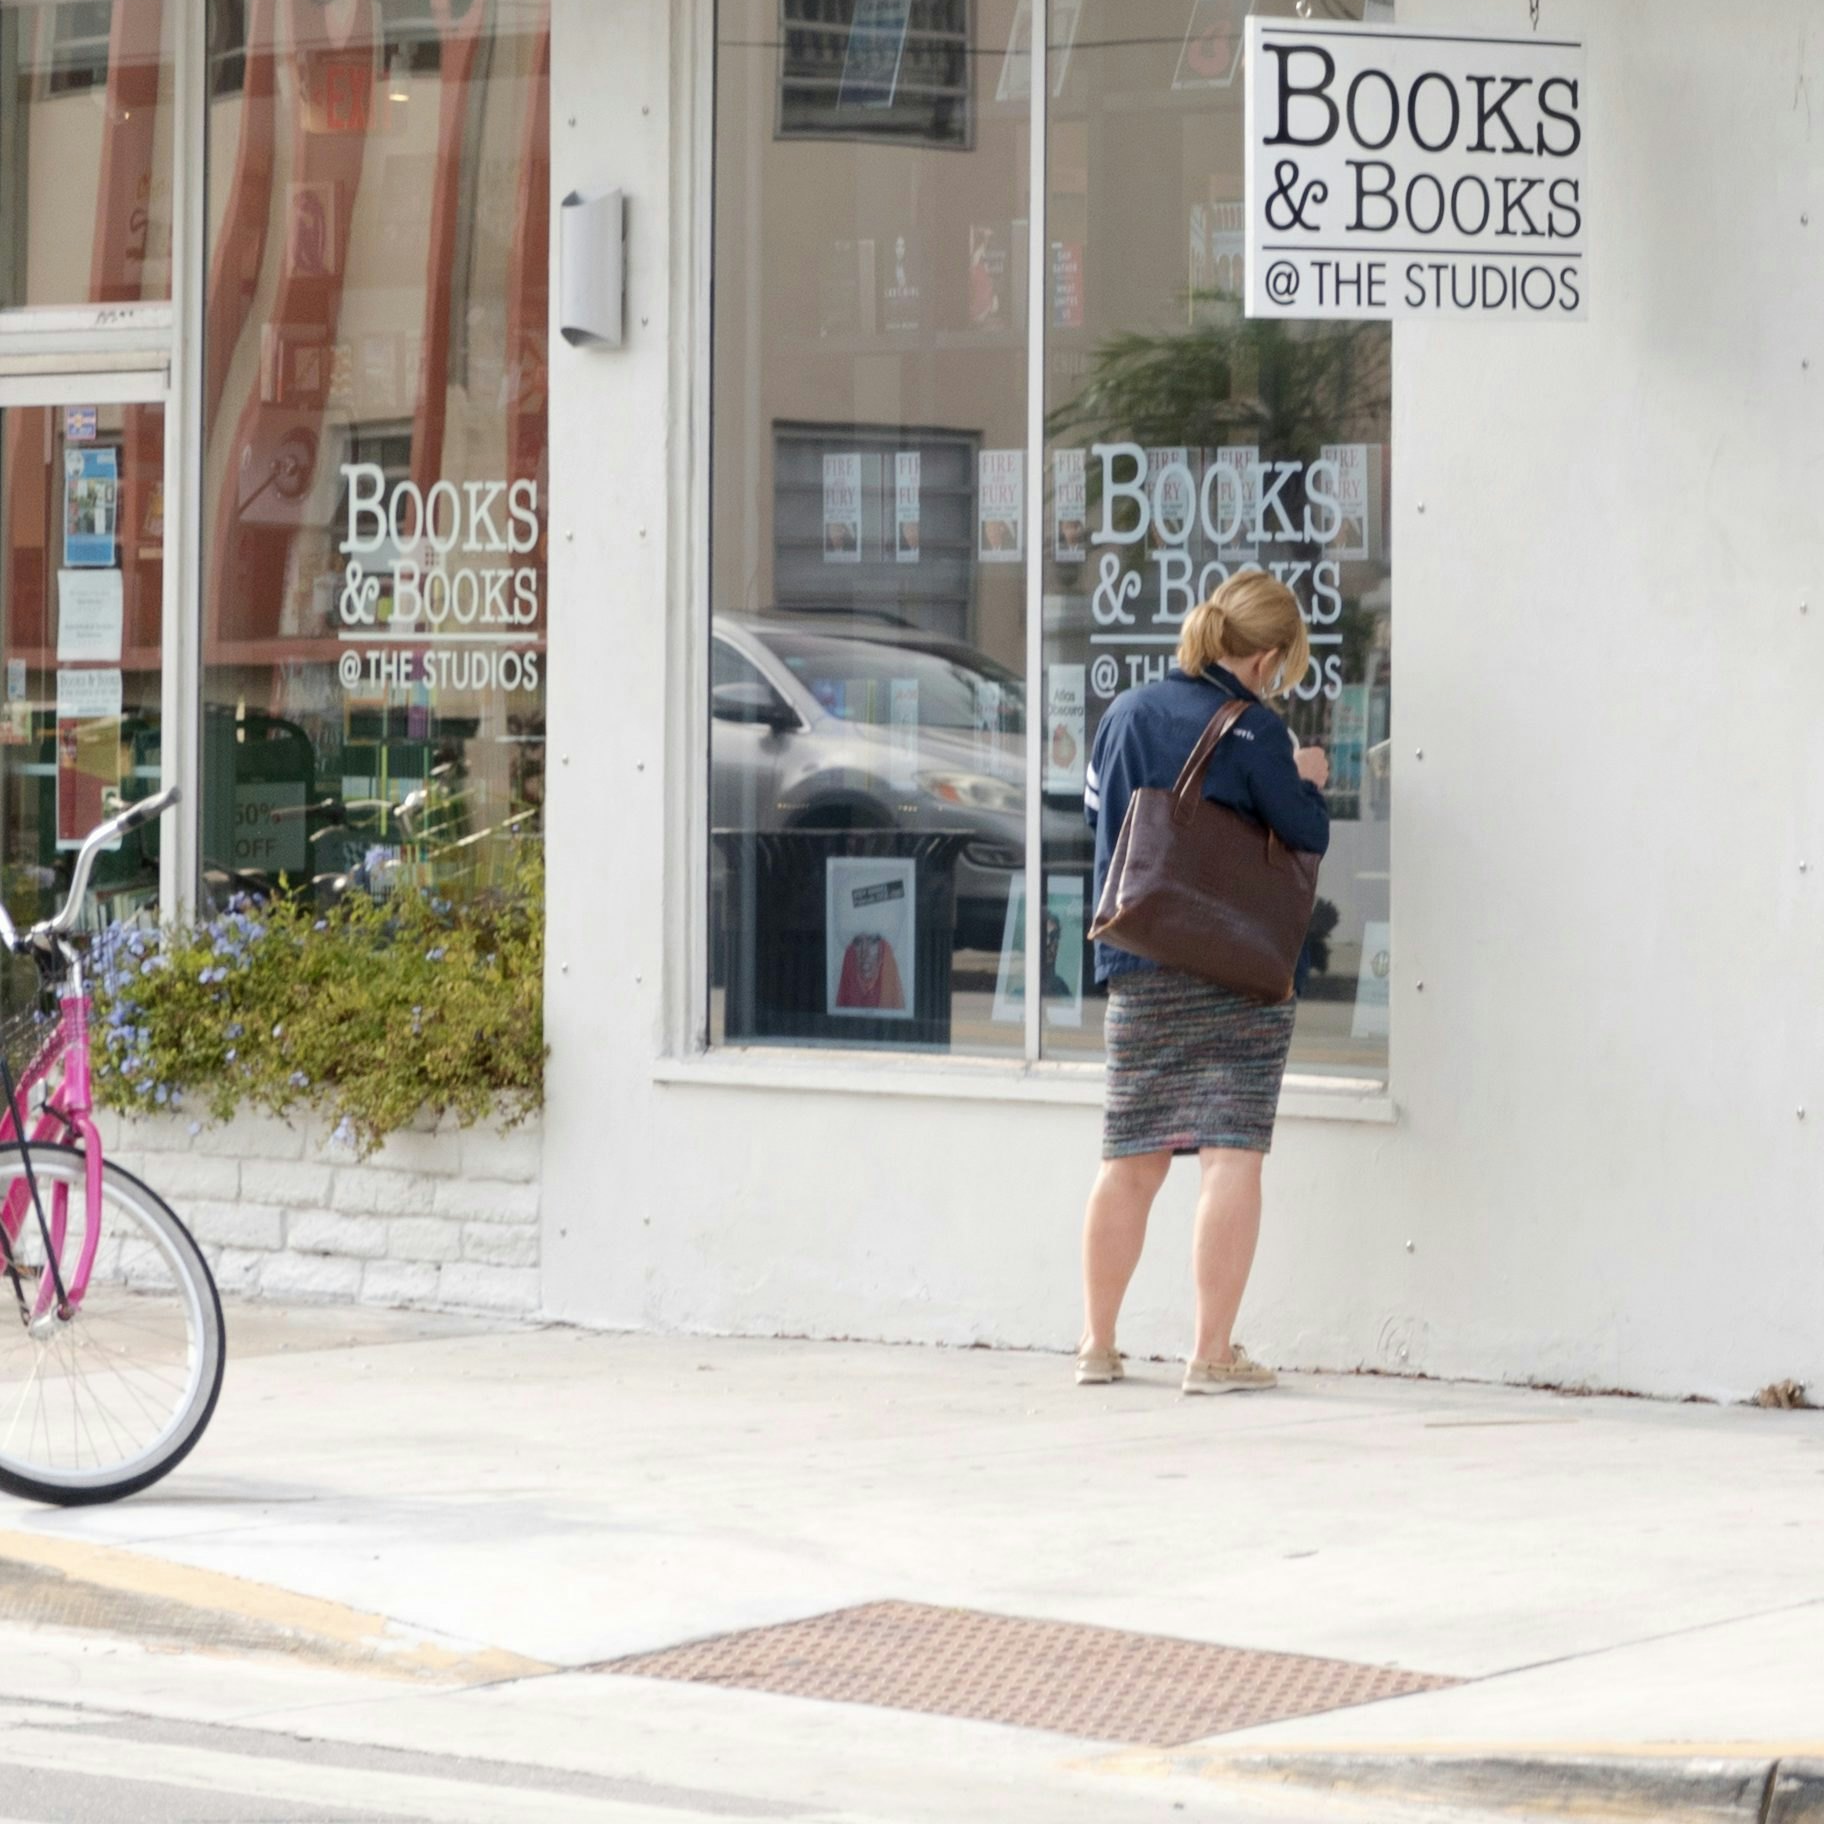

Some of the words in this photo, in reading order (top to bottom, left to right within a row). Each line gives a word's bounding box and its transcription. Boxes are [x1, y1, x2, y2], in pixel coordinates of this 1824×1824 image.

[1262, 42, 1582, 157] BOOKS
[1264, 159, 1328, 232] &
[1345, 159, 1582, 239] BOOKS
[1265, 260, 1300, 305] @
[1310, 261, 1387, 307] THE
[1404, 262, 1581, 311] STUDIOS
[338, 463, 539, 555] BOOKS
[1090, 442, 1343, 545] BOOKS
[338, 559, 380, 625] &
[387, 559, 538, 626] BOOKS
[1091, 552, 1142, 625] &
[338, 650, 361, 691] @
[365, 650, 414, 691] THE
[421, 650, 539, 692] STUDIOS
[1090, 654, 1119, 699] @
[234, 837, 279, 859] OFF
